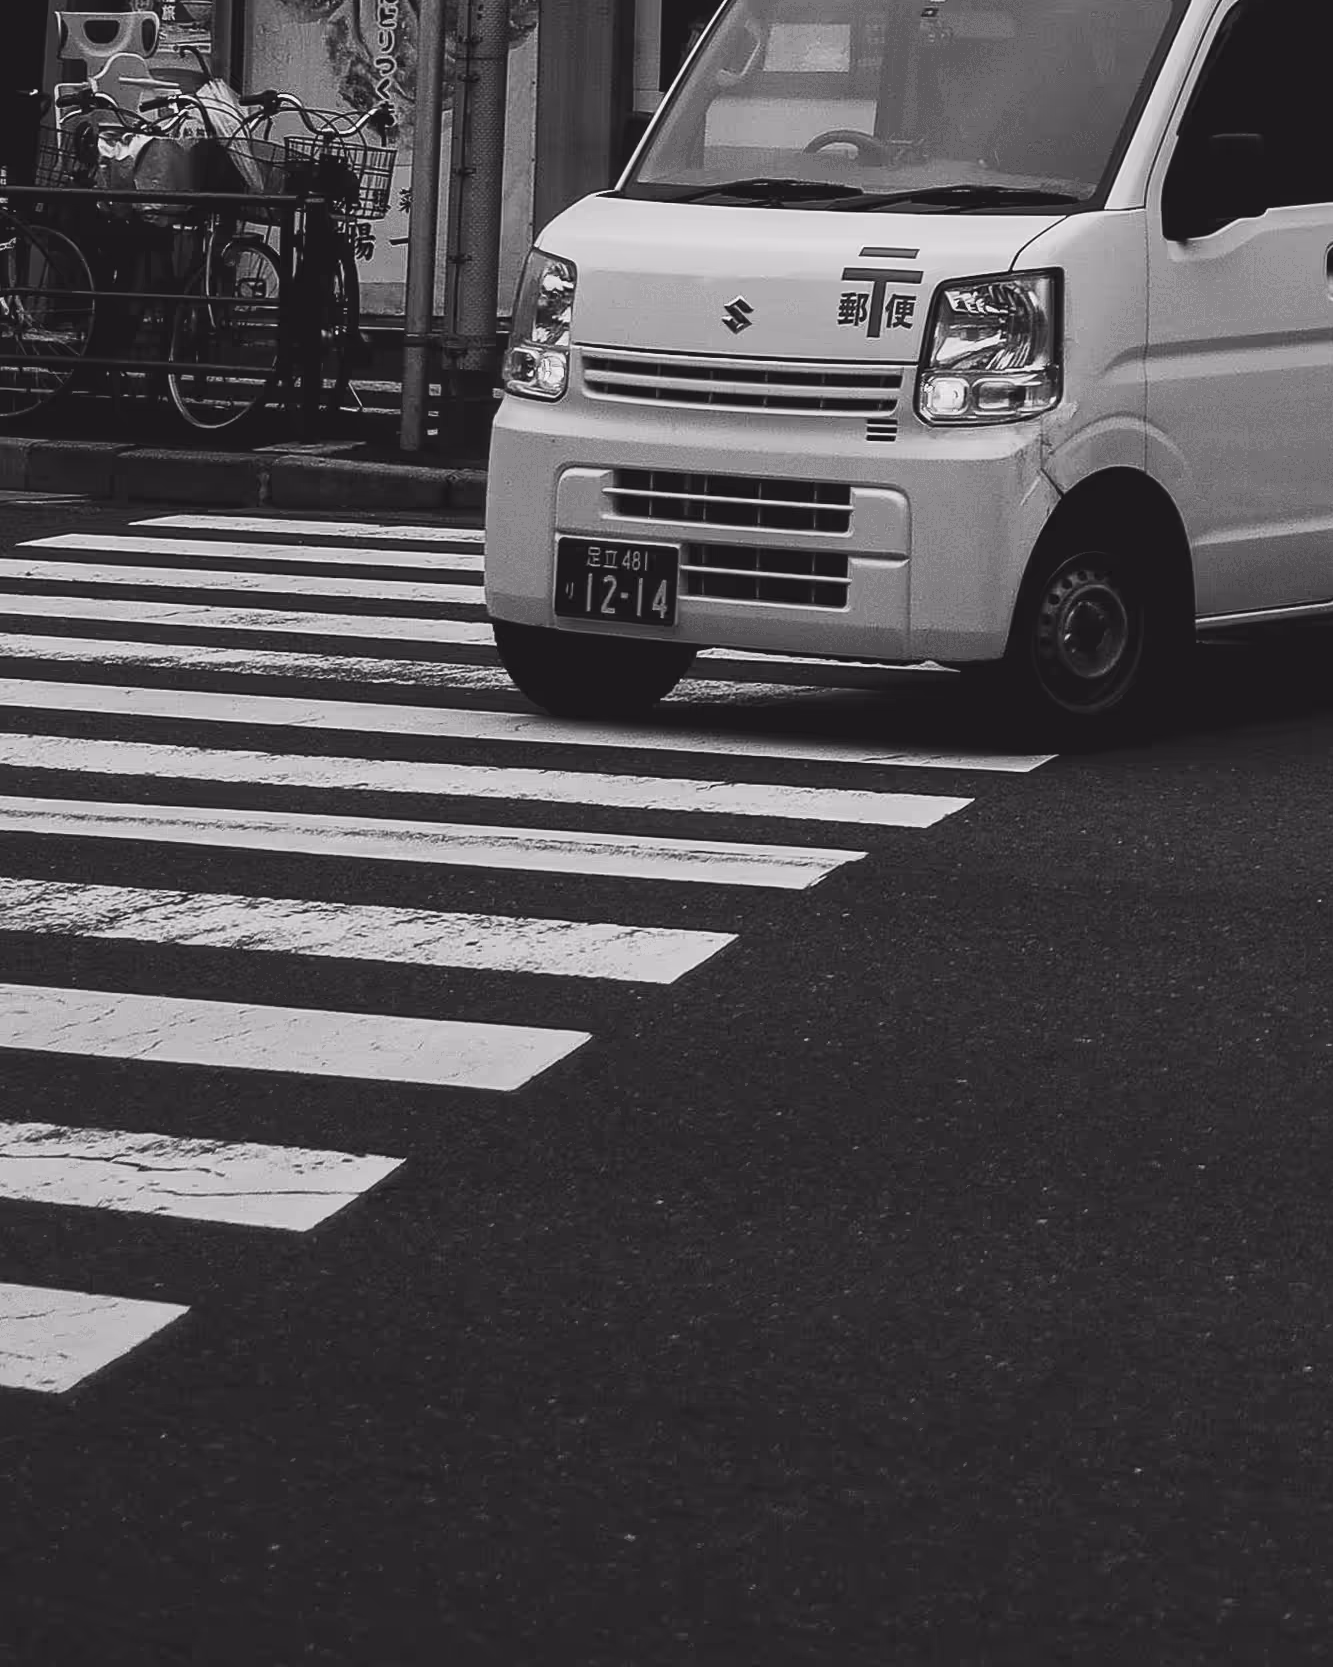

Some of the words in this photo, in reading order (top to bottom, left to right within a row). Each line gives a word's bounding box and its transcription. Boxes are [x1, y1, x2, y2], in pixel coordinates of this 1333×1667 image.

[586, 546, 619, 569] 足立
[621, 549, 649, 572] 481
[585, 572, 668, 619] 12-14
